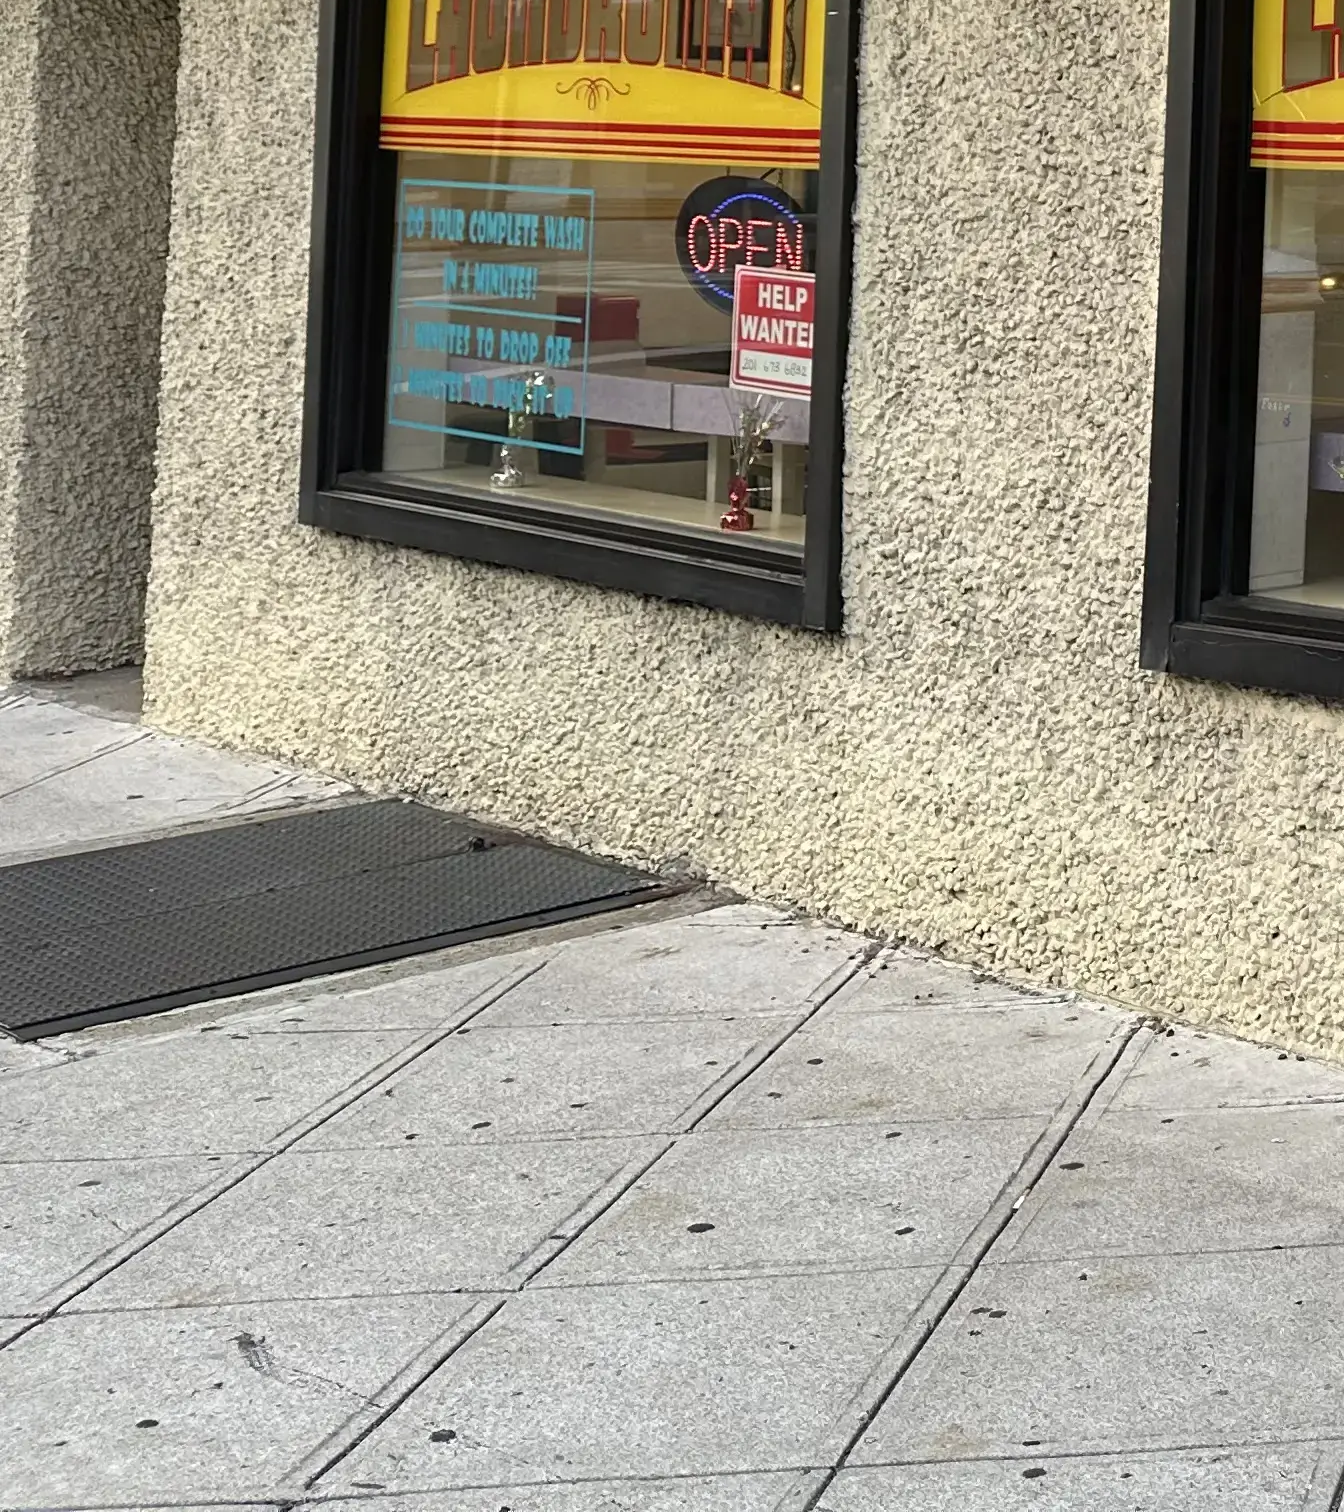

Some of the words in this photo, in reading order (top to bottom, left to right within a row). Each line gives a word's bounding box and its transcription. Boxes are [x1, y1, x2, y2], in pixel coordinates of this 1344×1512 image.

[407, 205, 424, 238] DO
[431, 208, 465, 241] YOUR
[469, 210, 539, 247] COMPLETE
[544, 215, 585, 251] WASH
[688, 215, 803, 273] OPEN
[474, 262, 538, 300] MINUTES!
[758, 283, 808, 313] HELP
[476, 327, 494, 359] TO
[501, 330, 539, 364] DROP
